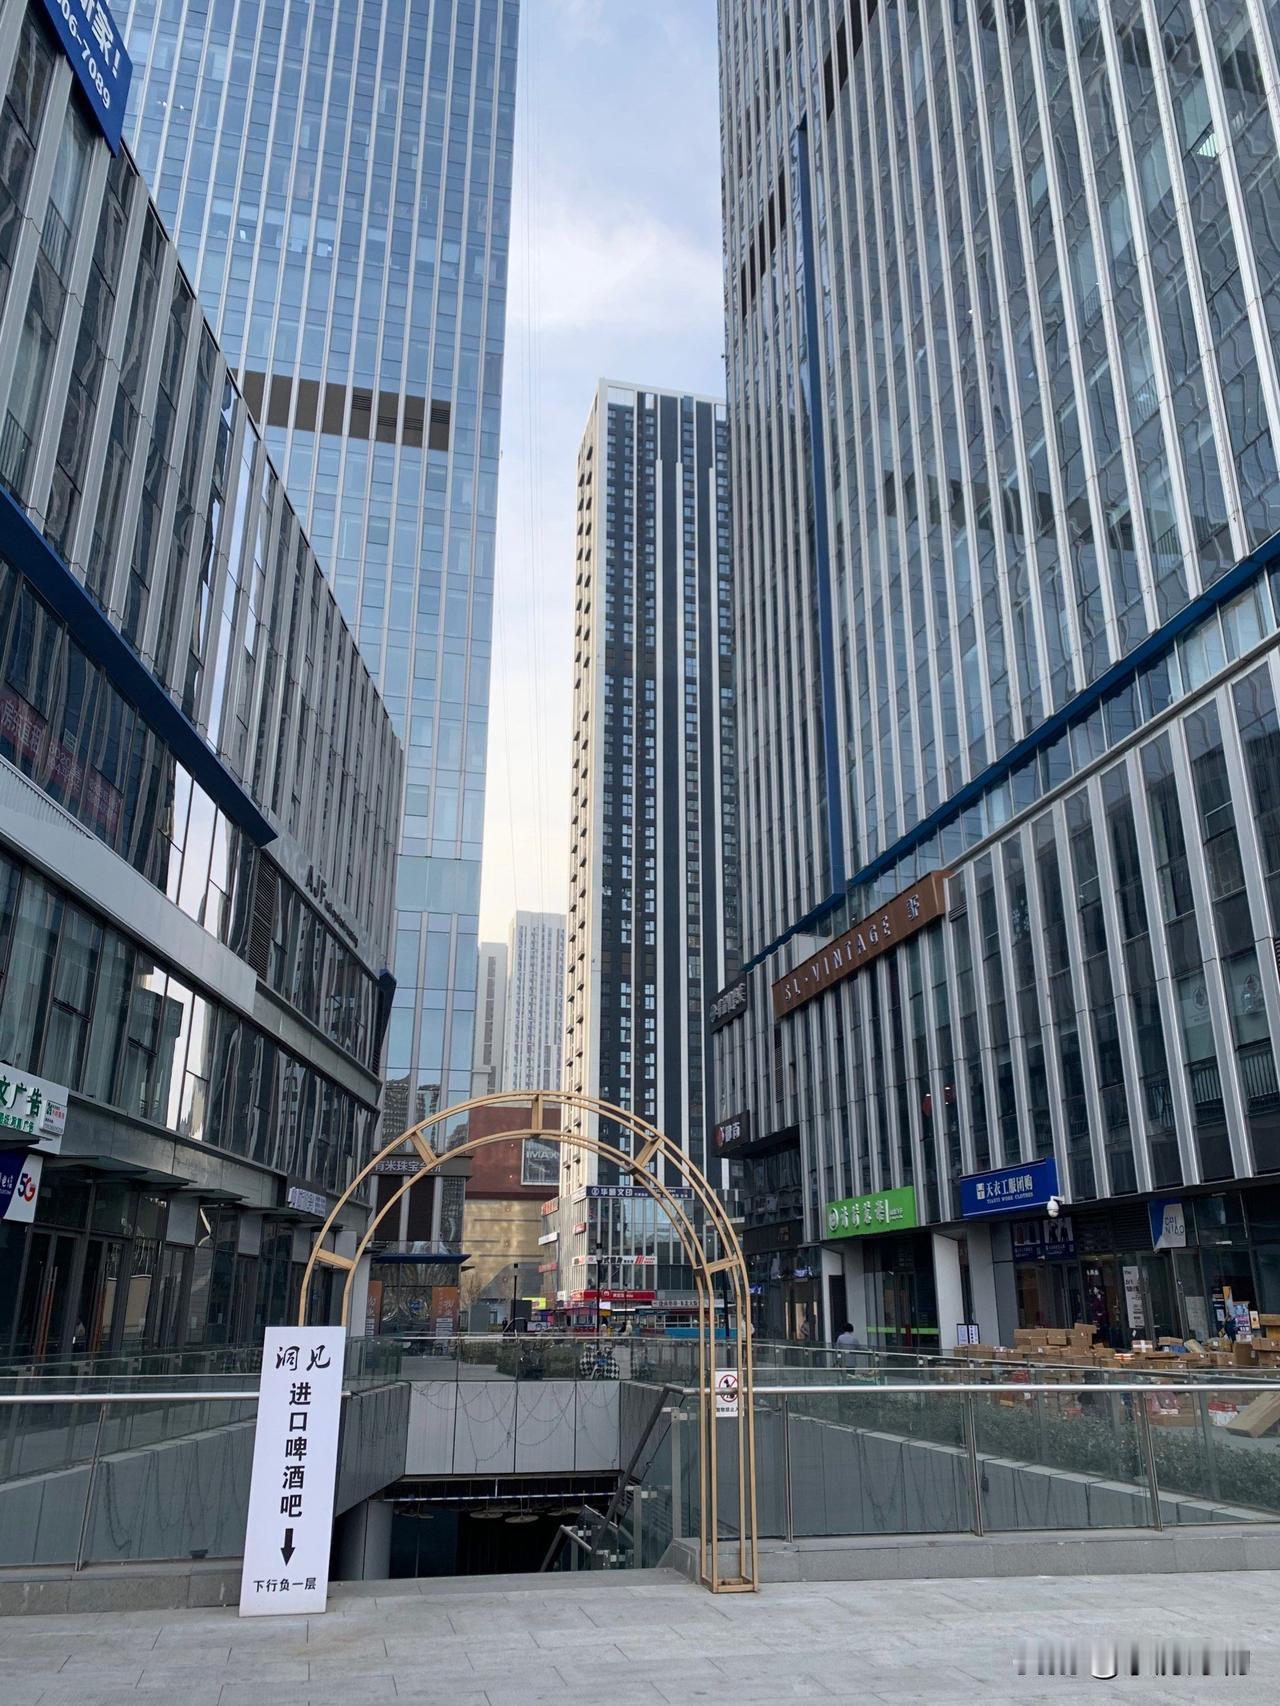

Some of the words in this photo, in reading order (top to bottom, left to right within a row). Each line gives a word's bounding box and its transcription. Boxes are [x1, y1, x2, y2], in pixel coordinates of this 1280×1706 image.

[81, 0, 121, 79] 家!
[56, 0, 111, 109] 06-7089
[526, 1150, 560, 1160] IMAX
[18, 1173, 36, 1201] 5G
[986, 1174, 1033, 1198] 天衣工服团购
[275, 1344, 331, 1372] 洞见
[280, 1381, 312, 1518] 进口啤酒吧
[253, 1577, 317, 1593] 下行负一层
